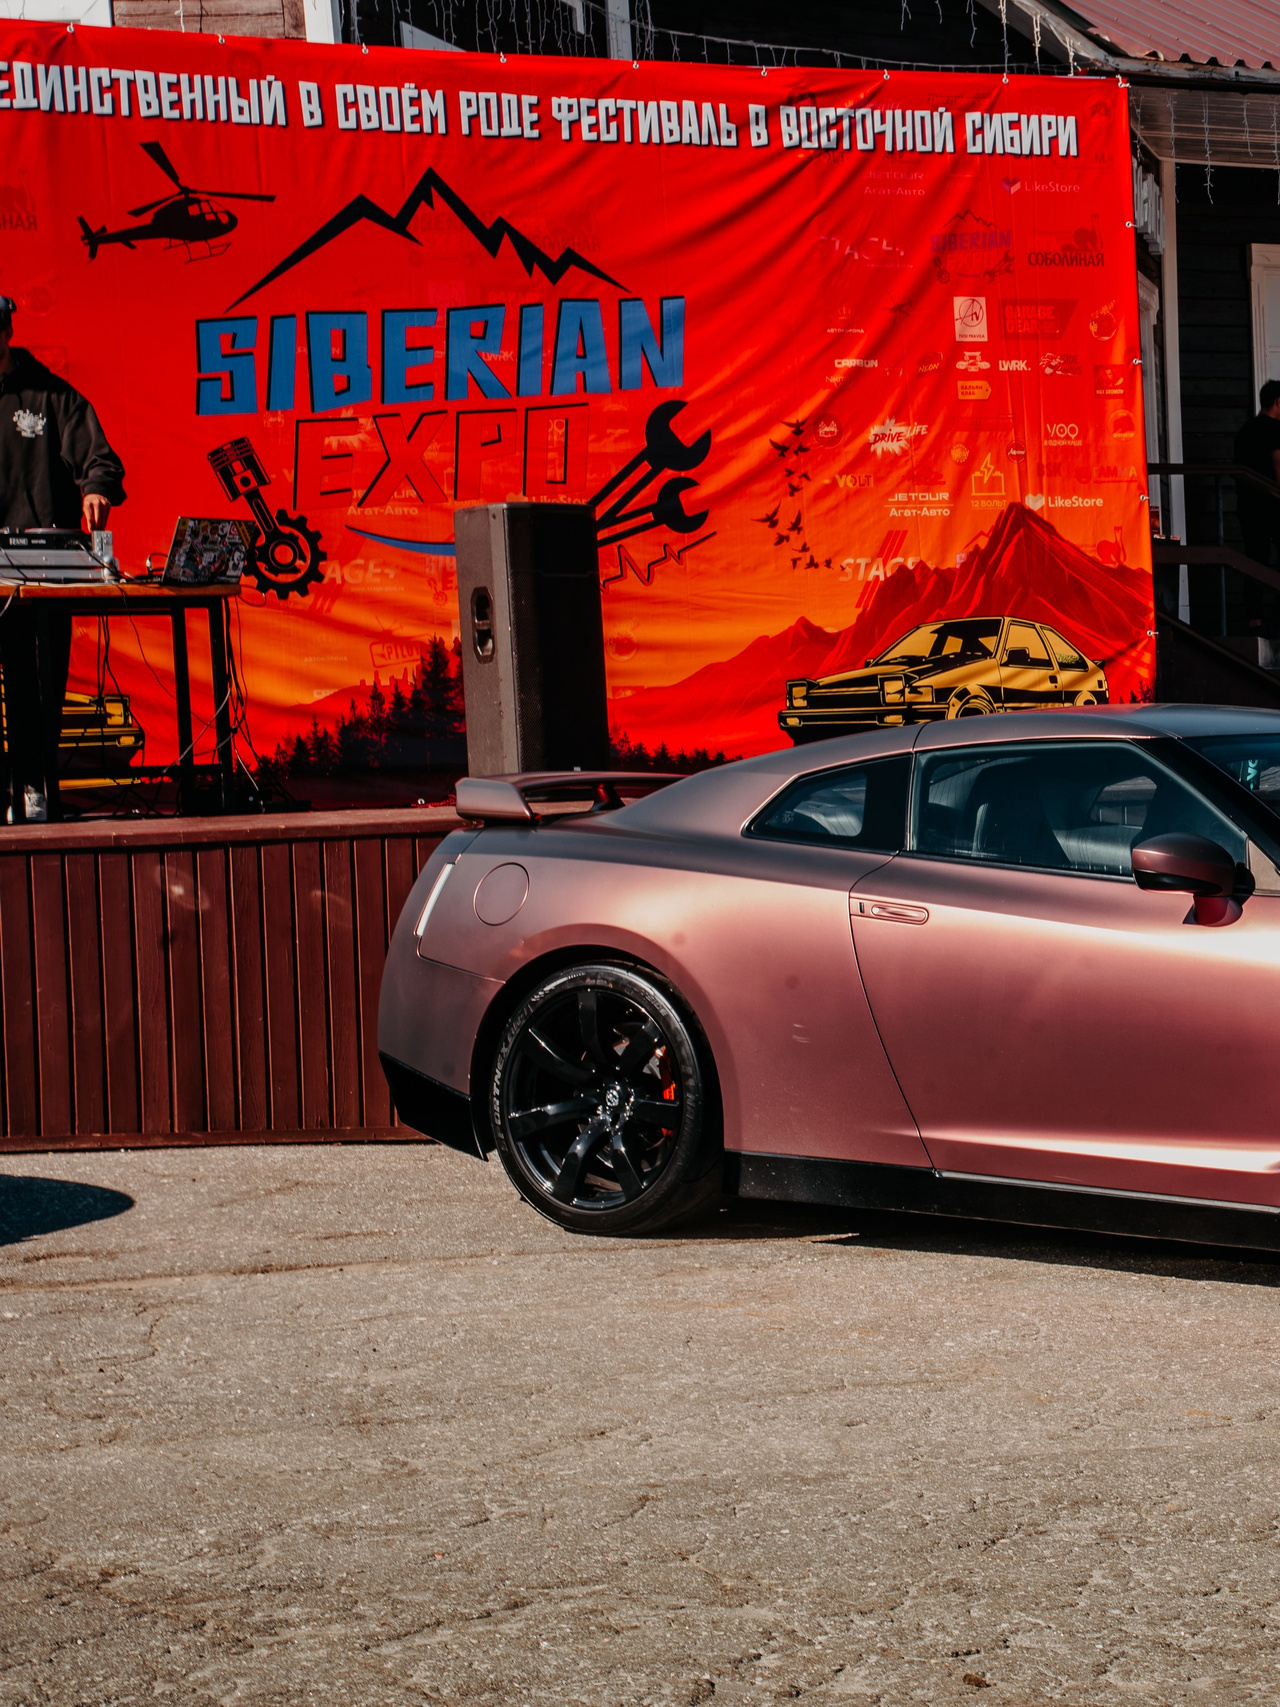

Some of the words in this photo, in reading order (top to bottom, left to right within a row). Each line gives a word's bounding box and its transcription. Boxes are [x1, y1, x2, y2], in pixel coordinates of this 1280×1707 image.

[299, 81, 322, 127] В
[335, 82, 447, 135] СВОЁМ
[459, 91, 540, 139] РОДЕ
[551, 95, 737, 147] ФЕСТИВАЛЬ
[749, 104, 769, 148] В
[780, 105, 955, 154] ВОСТОЧНОЙ
[965, 112, 1078, 157] СИБИРИ
[1025, 181, 1080, 193] LikeStore
[1028, 252, 1104, 267] СОБОЛИНАЯ
[1005, 305, 1055, 320] GARAGE
[195, 295, 686, 416] SIBERIAN
[295, 402, 589, 510] EXPO
[835, 474, 873, 488] VOLT
[888, 493, 949, 501] JETOUR
[1048, 496, 1103, 508] LikeStore
[981, 500, 1006, 508] ВОЛЬТ
[347, 506, 418, 516] Агат-Авто
[889, 507, 950, 517] Агат-Авто
